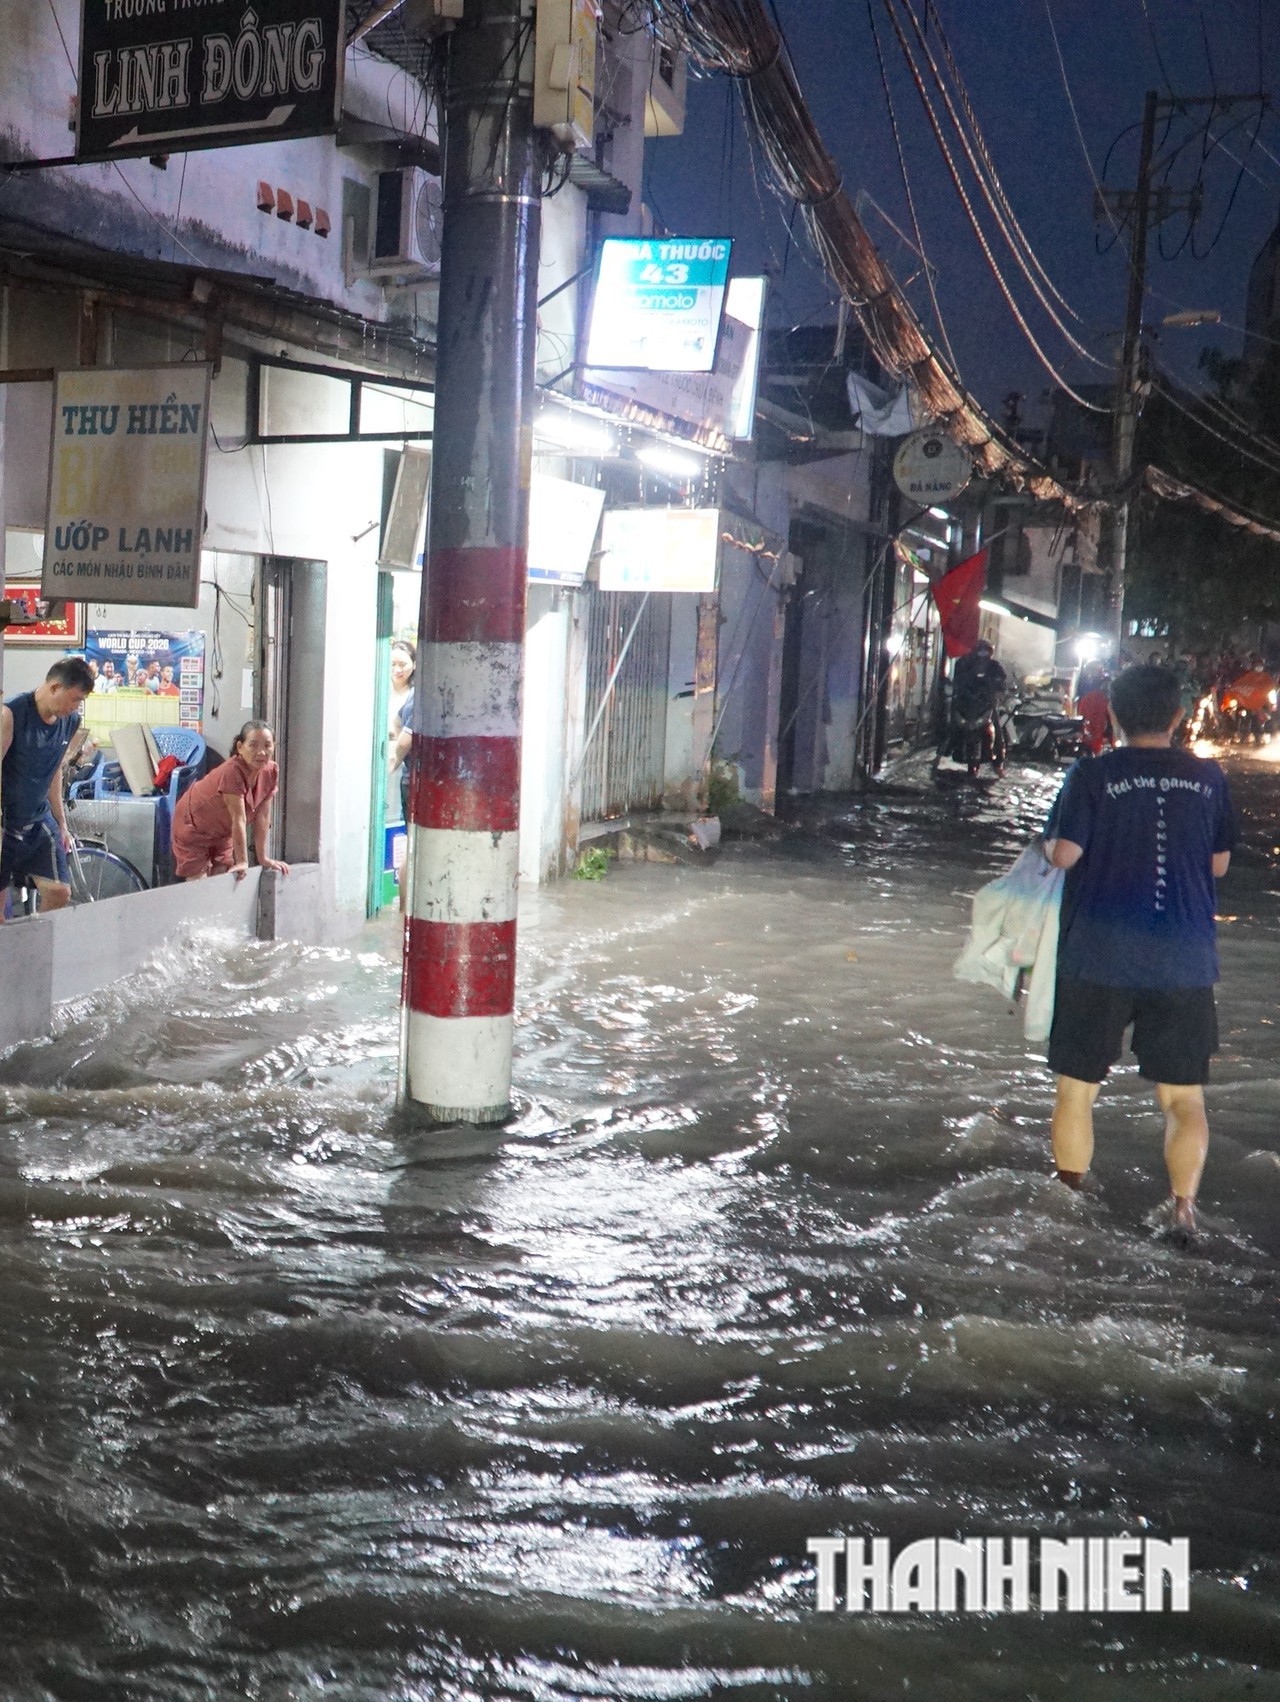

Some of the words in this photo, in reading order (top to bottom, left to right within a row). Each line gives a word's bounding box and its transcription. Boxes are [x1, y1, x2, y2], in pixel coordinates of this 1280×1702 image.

[92, 38, 193, 118] LINH
[200, 6, 325, 104] ĐÔNG
[660, 240, 726, 261] THUỐC
[640, 263, 689, 285] 43
[62, 405, 120, 435] THU
[126, 392, 202, 435] HIỀN
[55, 519, 109, 551] ƯỚP
[119, 526, 193, 558] LẠNH
[53, 558, 74, 577] CÁC
[77, 559, 101, 578] MÓN
[99, 637, 126, 649] WORLD
[129, 638, 146, 650] CUP
[148, 638, 170, 650] 2026
[1106, 778, 1132, 799] feel
[1134, 775, 1156, 788] the
[1160, 777, 1201, 792] game
